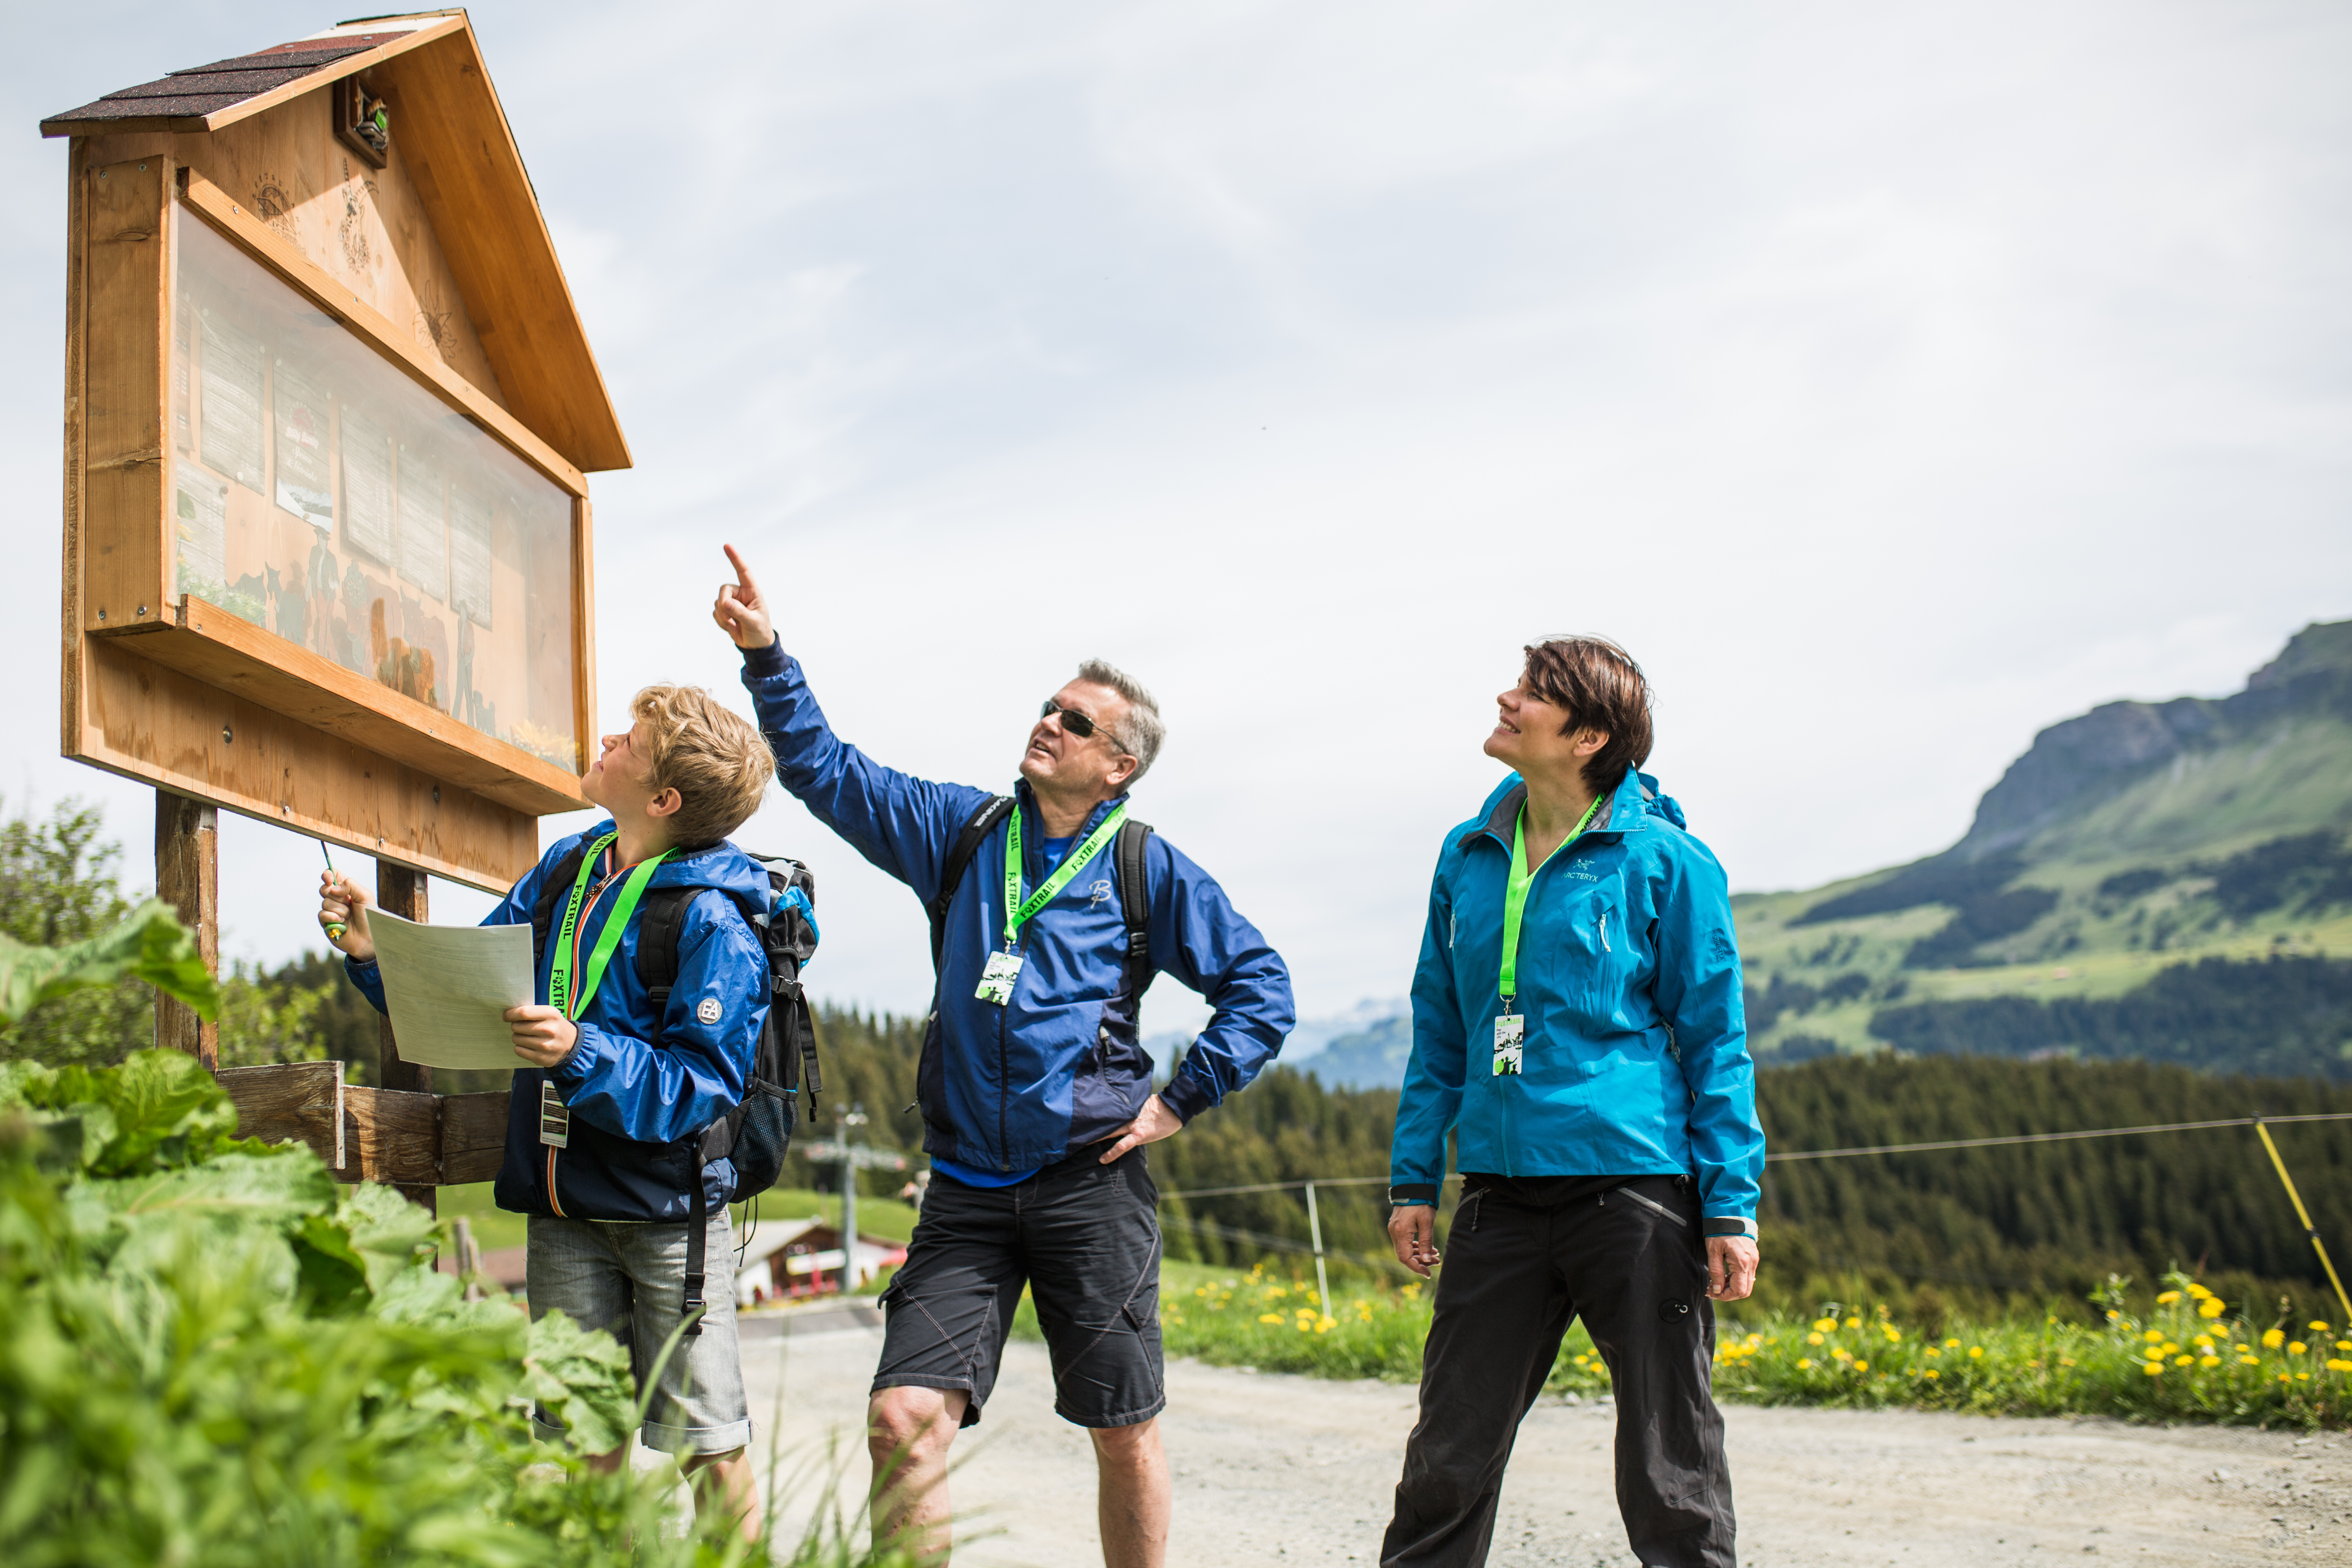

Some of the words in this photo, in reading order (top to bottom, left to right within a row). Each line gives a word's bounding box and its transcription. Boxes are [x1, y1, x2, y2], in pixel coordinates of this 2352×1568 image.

[292, 445, 312, 464] Speisen
[287, 459, 293, 467] &
[294, 461, 317, 482] Getränke
[590, 831, 616, 857] TRAIL
[553, 969, 565, 1017] FOXTRA
[701, 1002, 718, 1020] EA
